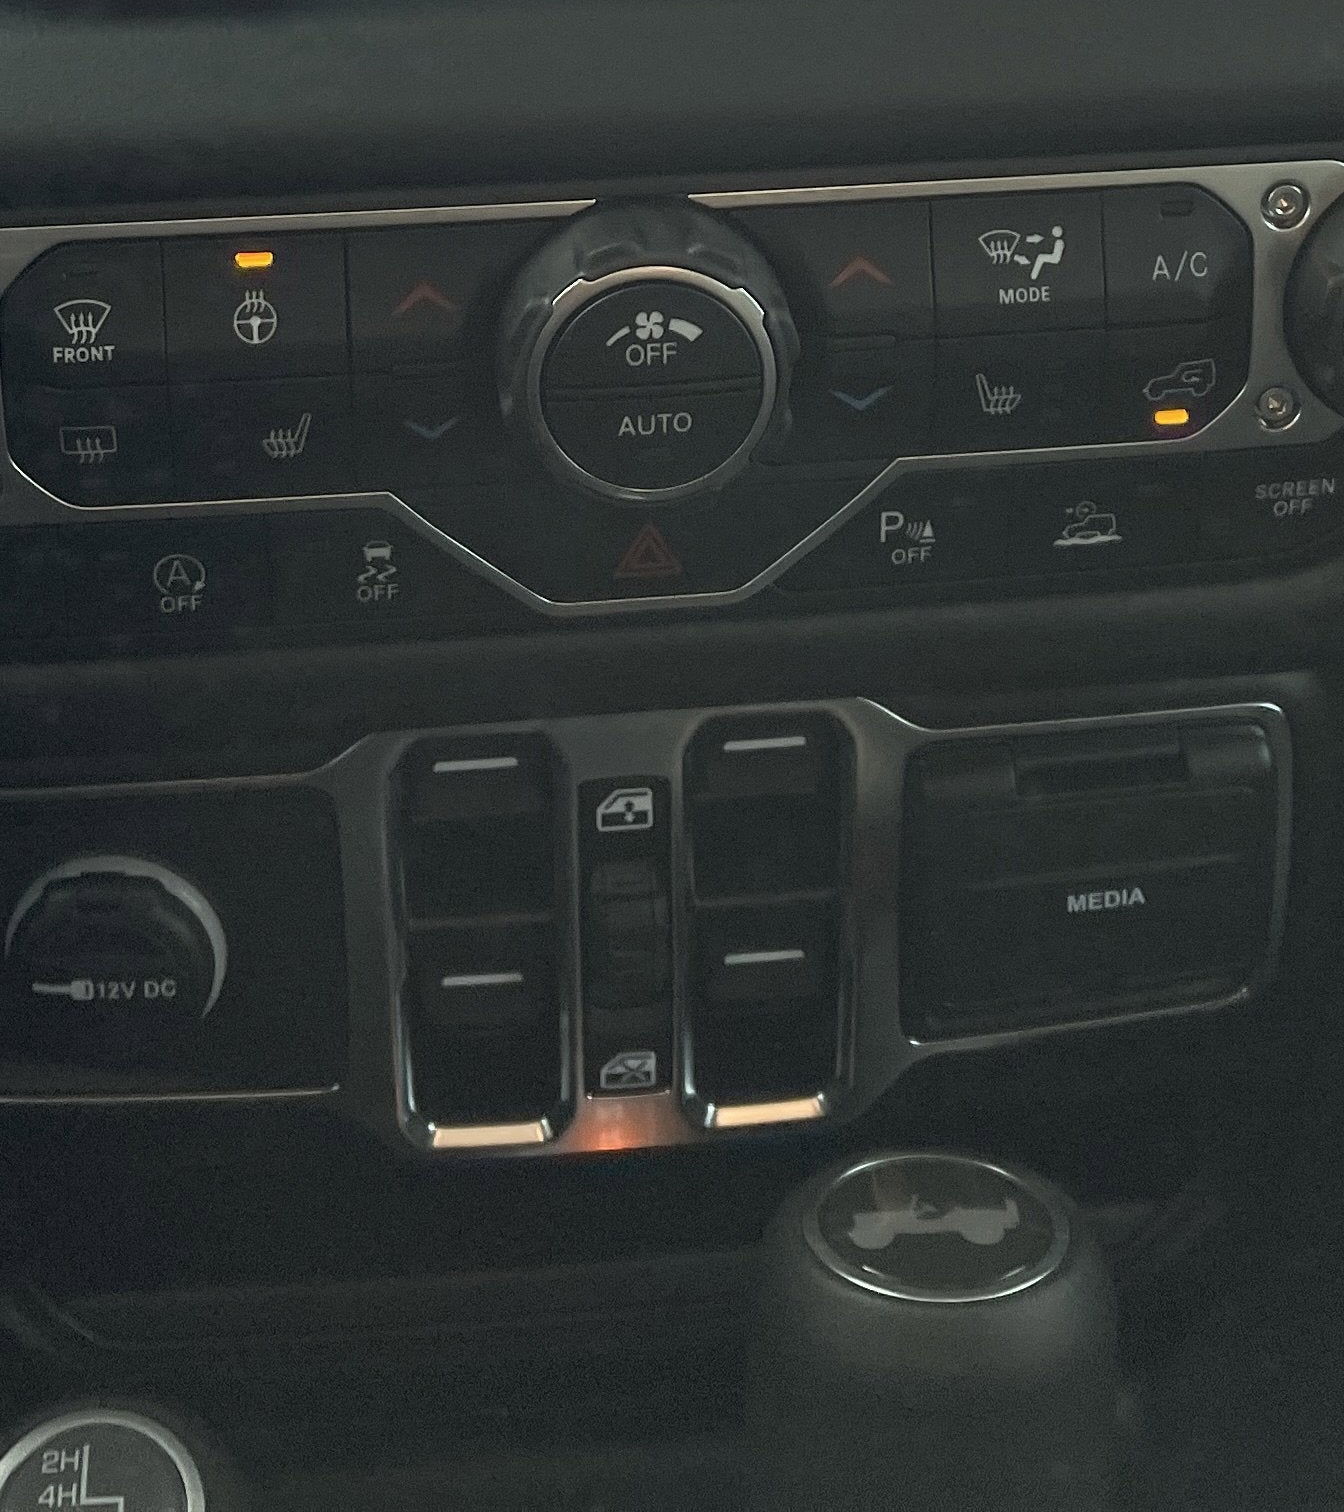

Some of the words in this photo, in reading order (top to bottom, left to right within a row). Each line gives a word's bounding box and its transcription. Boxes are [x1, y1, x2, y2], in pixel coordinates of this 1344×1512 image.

[1152, 251, 1209, 282] A/C
[998, 286, 1051, 306] MODE
[52, 344, 115, 364] FRONT
[625, 342, 679, 368] OFF
[616, 411, 693, 438] AUTO
[1254, 478, 1336, 501] SCREEN
[1273, 498, 1313, 518] OFF
[879, 511, 905, 543] P
[891, 546, 933, 566] OFF
[160, 593, 205, 614] OFF
[357, 582, 400, 603] OFF
[1066, 886, 1147, 914] MEDIA
[95, 980, 137, 1000] 12V
[144, 979, 177, 999] DC
[41, 1447, 80, 1474] 2H
[37, 1483, 78, 1508] 4H
